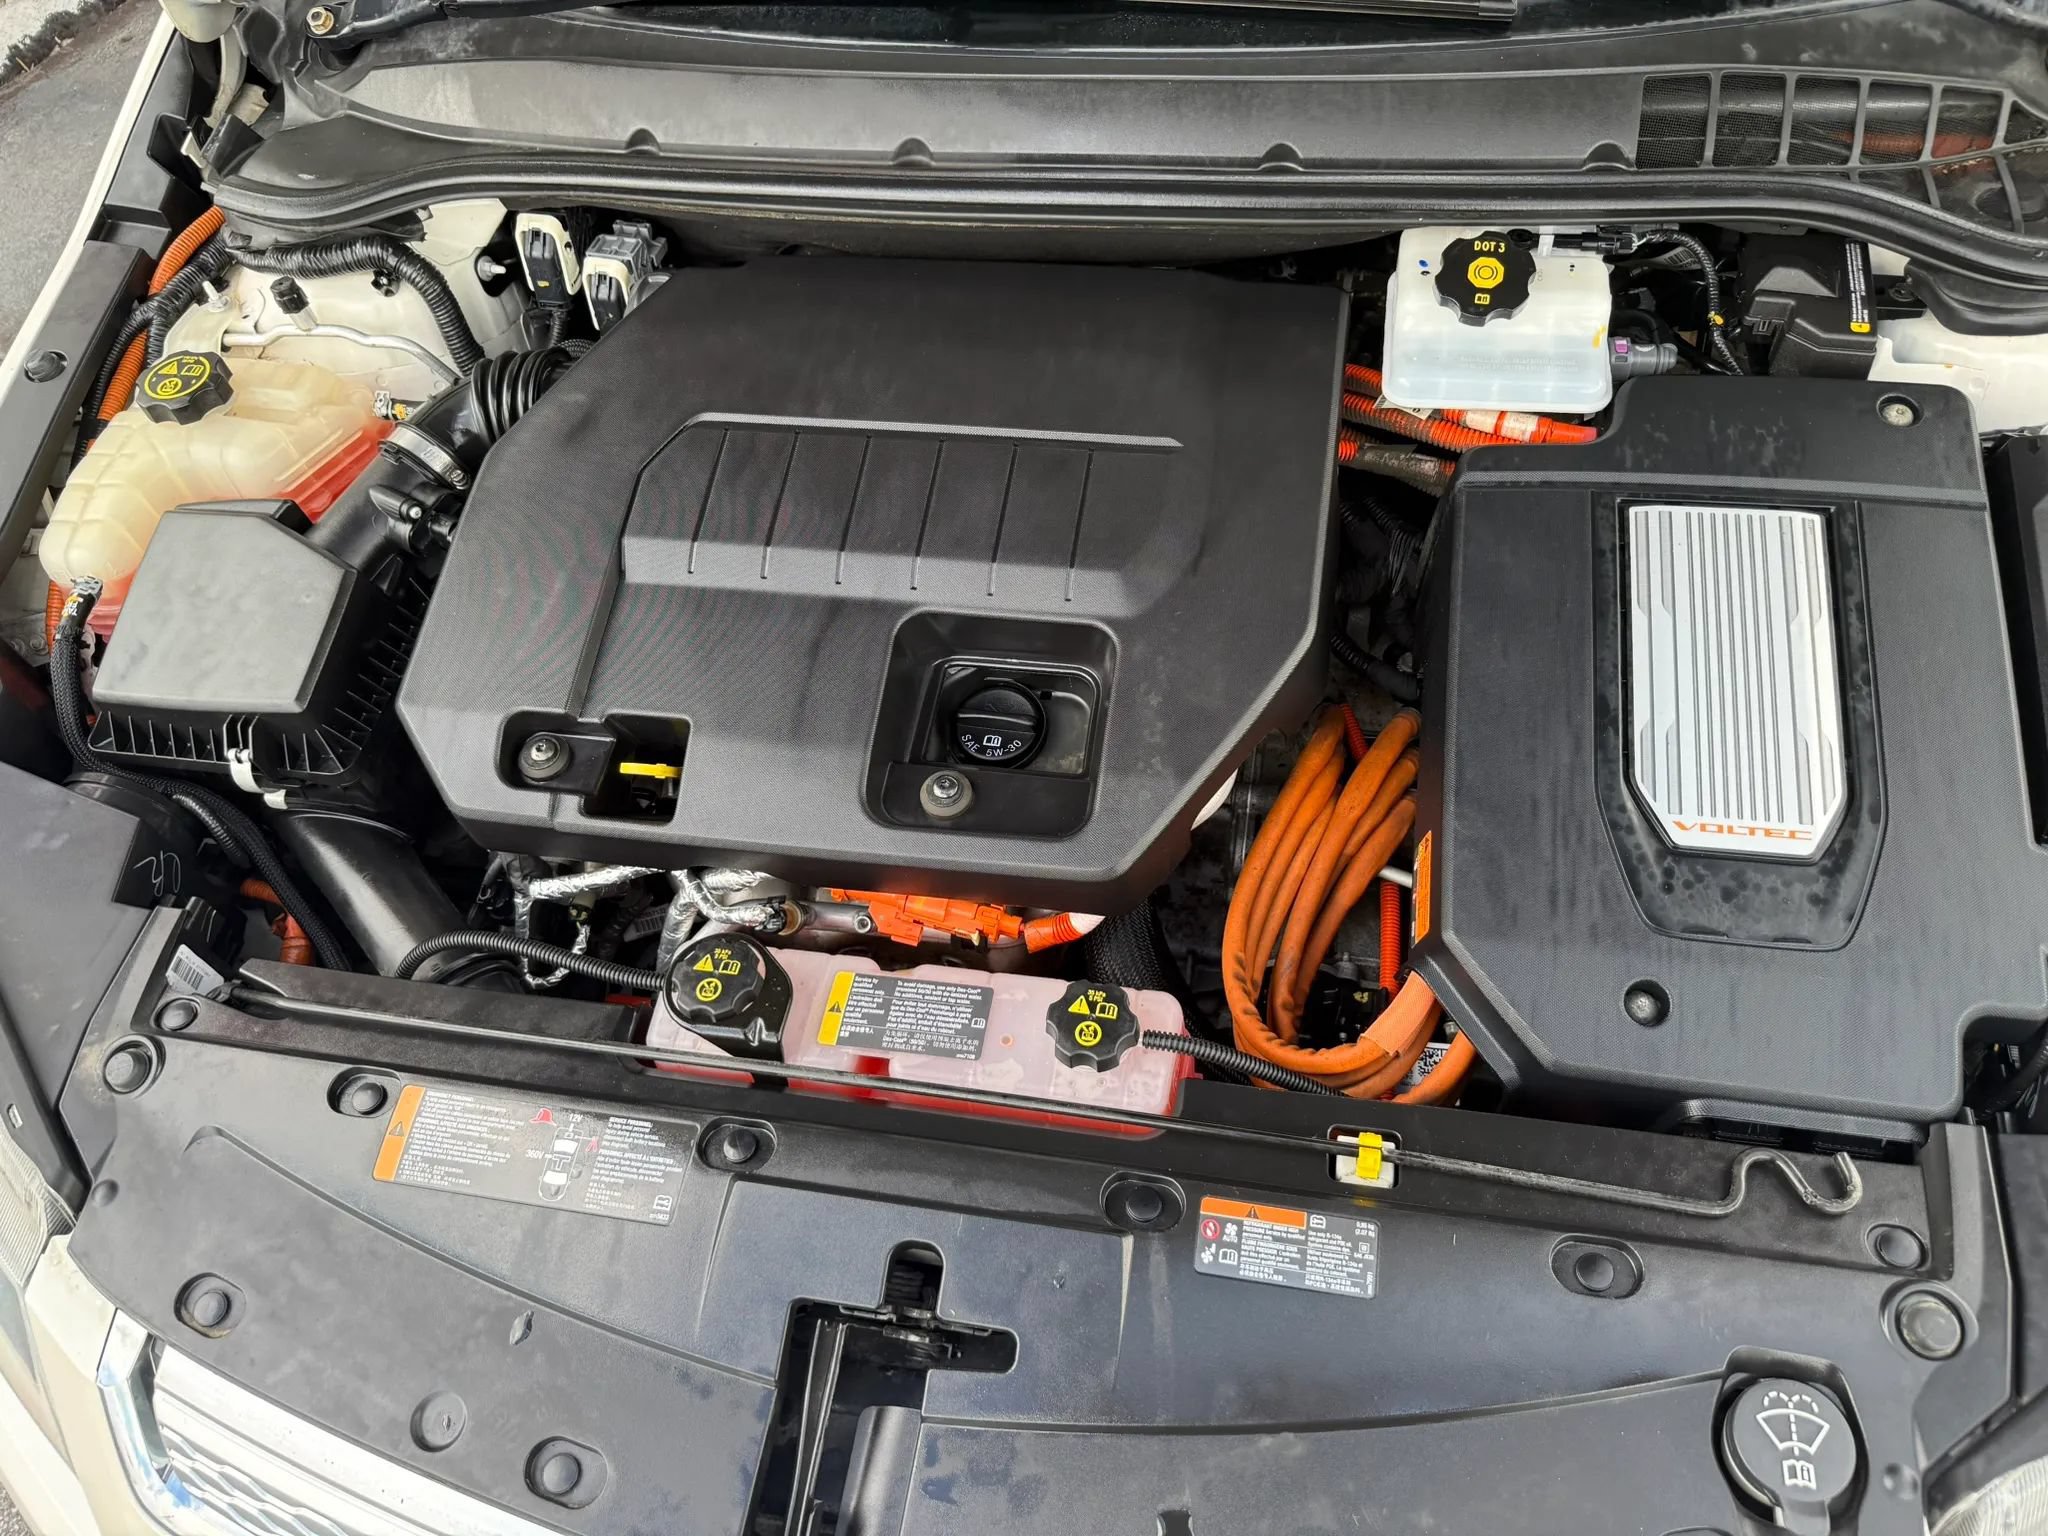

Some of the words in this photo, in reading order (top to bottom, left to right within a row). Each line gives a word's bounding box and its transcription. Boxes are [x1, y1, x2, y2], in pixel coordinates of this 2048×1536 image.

[1474, 240, 1496, 252] DOT
[1497, 243, 1506, 253] 3
[961, 734, 981, 753] SAE
[985, 739, 1022, 757] 5W-30
[1672, 820, 1813, 841] VOLTEC
[568, 1113, 584, 1122] 12V
[524, 1149, 545, 1160] 360V
[1222, 1234, 1238, 1243] AUTO
